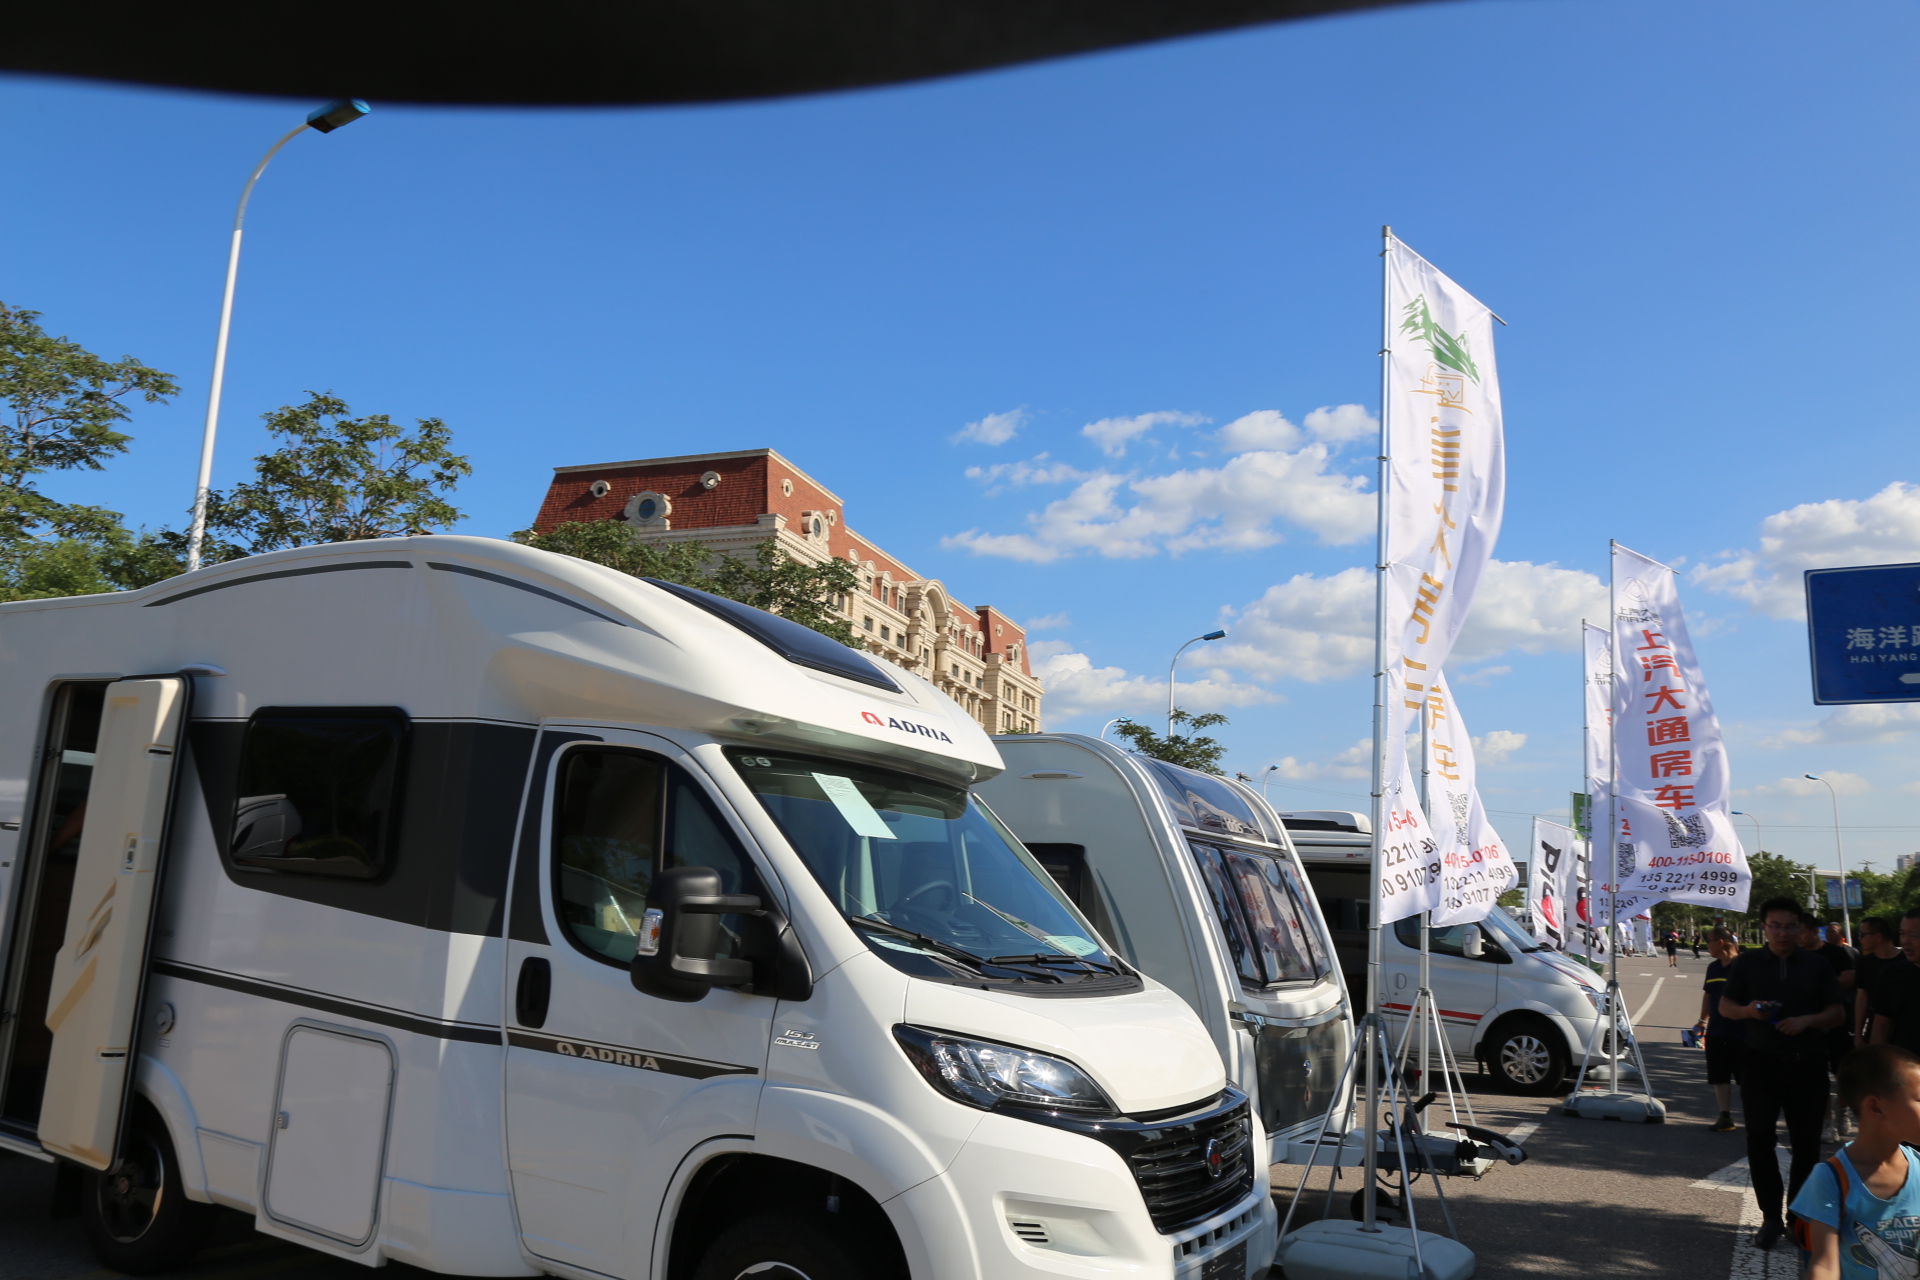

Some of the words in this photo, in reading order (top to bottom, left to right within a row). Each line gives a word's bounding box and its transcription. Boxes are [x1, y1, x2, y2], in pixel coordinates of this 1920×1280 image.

[1850, 655, 1875, 664] HAI
[1878, 653, 1918, 663] YANG
[1636, 629, 1696, 811] 上汽大通房车
[888, 717, 954, 745] ADRIA
[1647, 851, 1733, 868] 400-115-0106
[1700, 871, 1738, 883] 4999
[1698, 883, 1736, 897] 8999
[581, 1046, 661, 1071] ADRIA
[1877, 1216, 1920, 1230] SPACE
